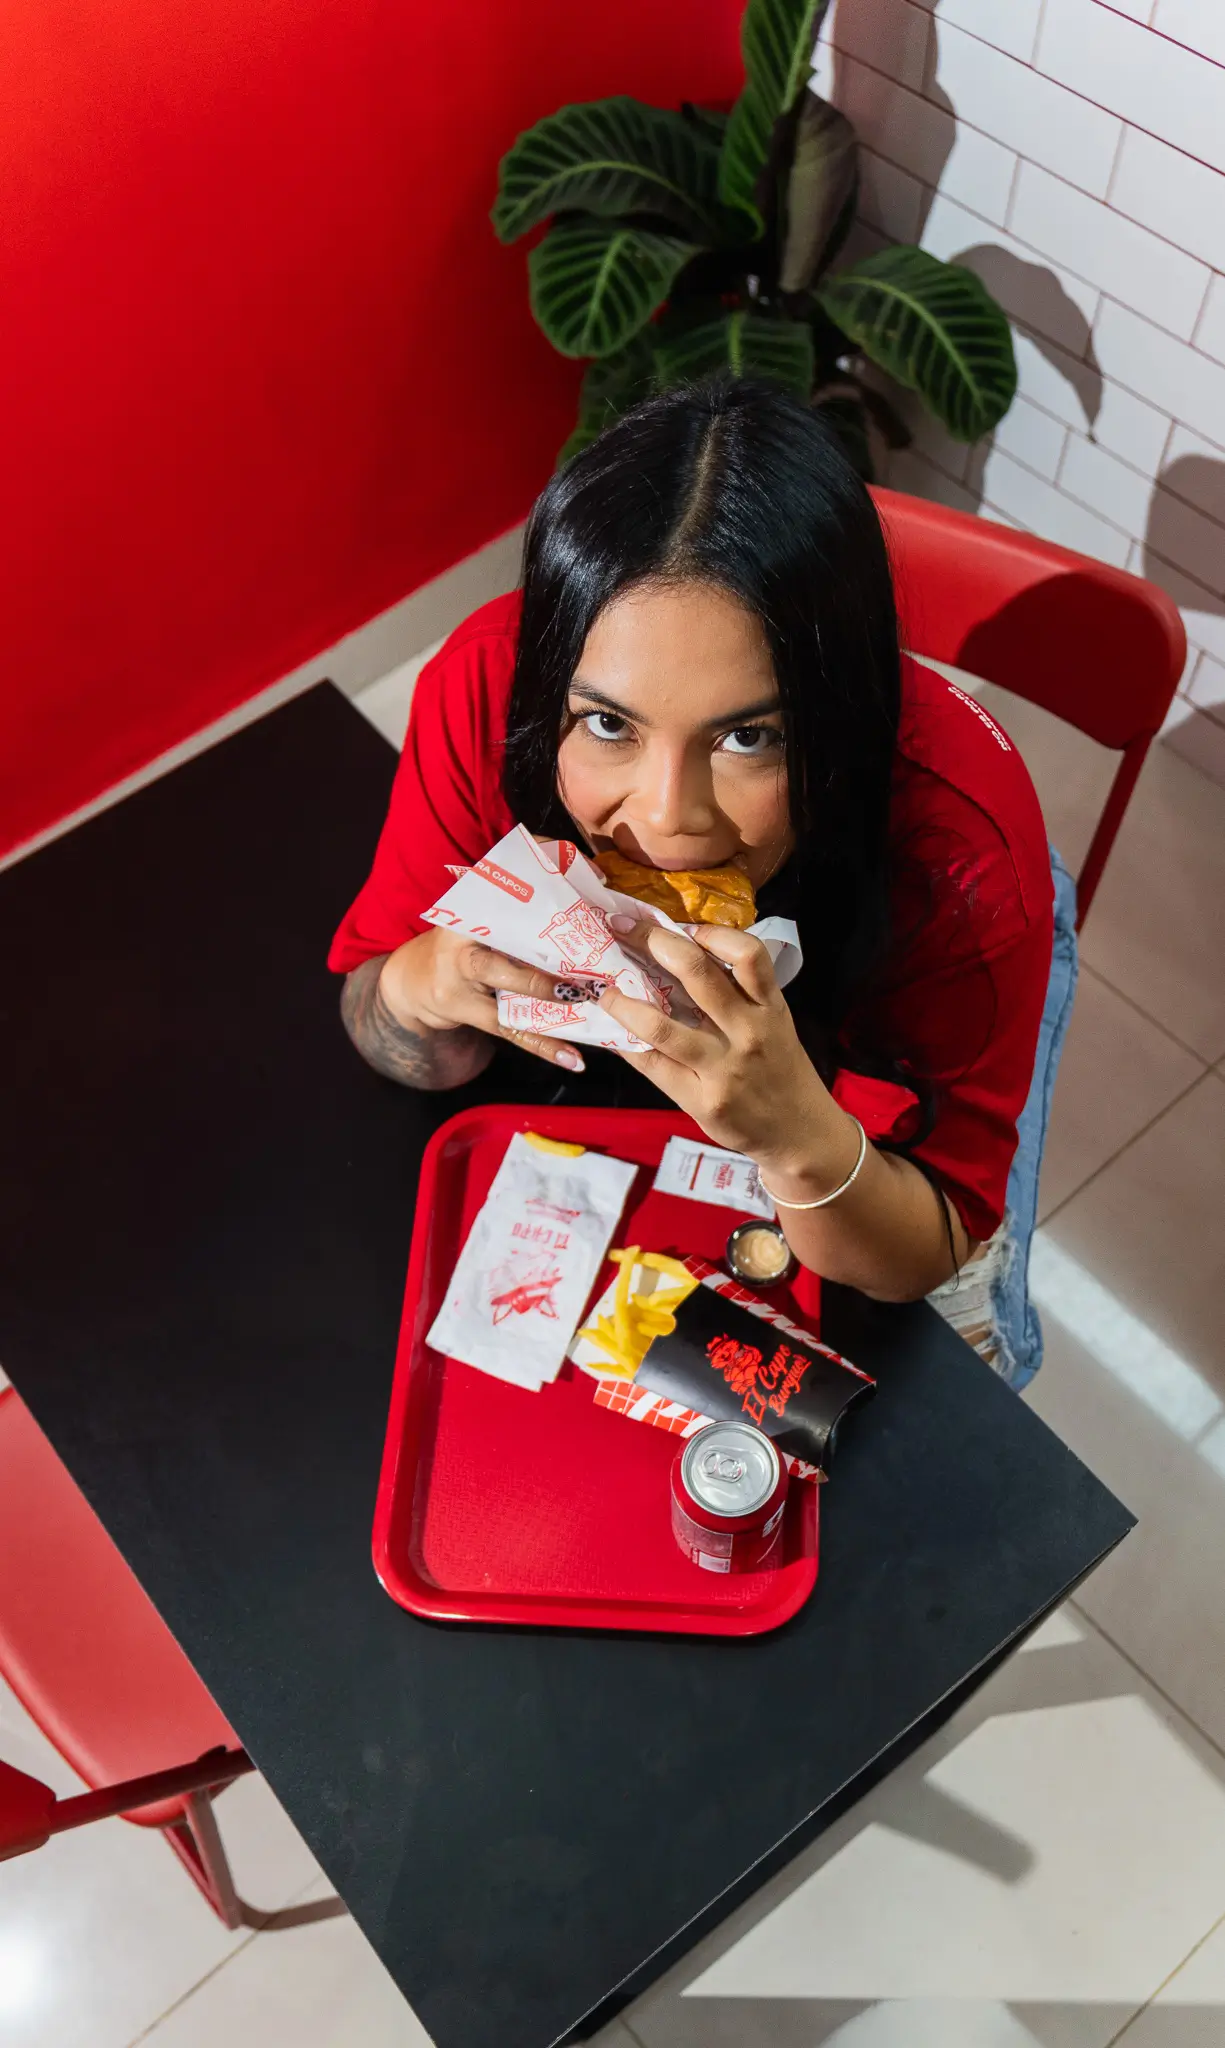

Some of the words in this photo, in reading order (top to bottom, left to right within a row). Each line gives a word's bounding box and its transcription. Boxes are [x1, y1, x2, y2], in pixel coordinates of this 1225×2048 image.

[991, 730, 1008, 751] NO
[491, 870, 529, 898] CAPOS
[714, 1163, 732, 1190] TOMATE
[741, 1386, 767, 1426] El
[758, 1344, 791, 1390] Capo
